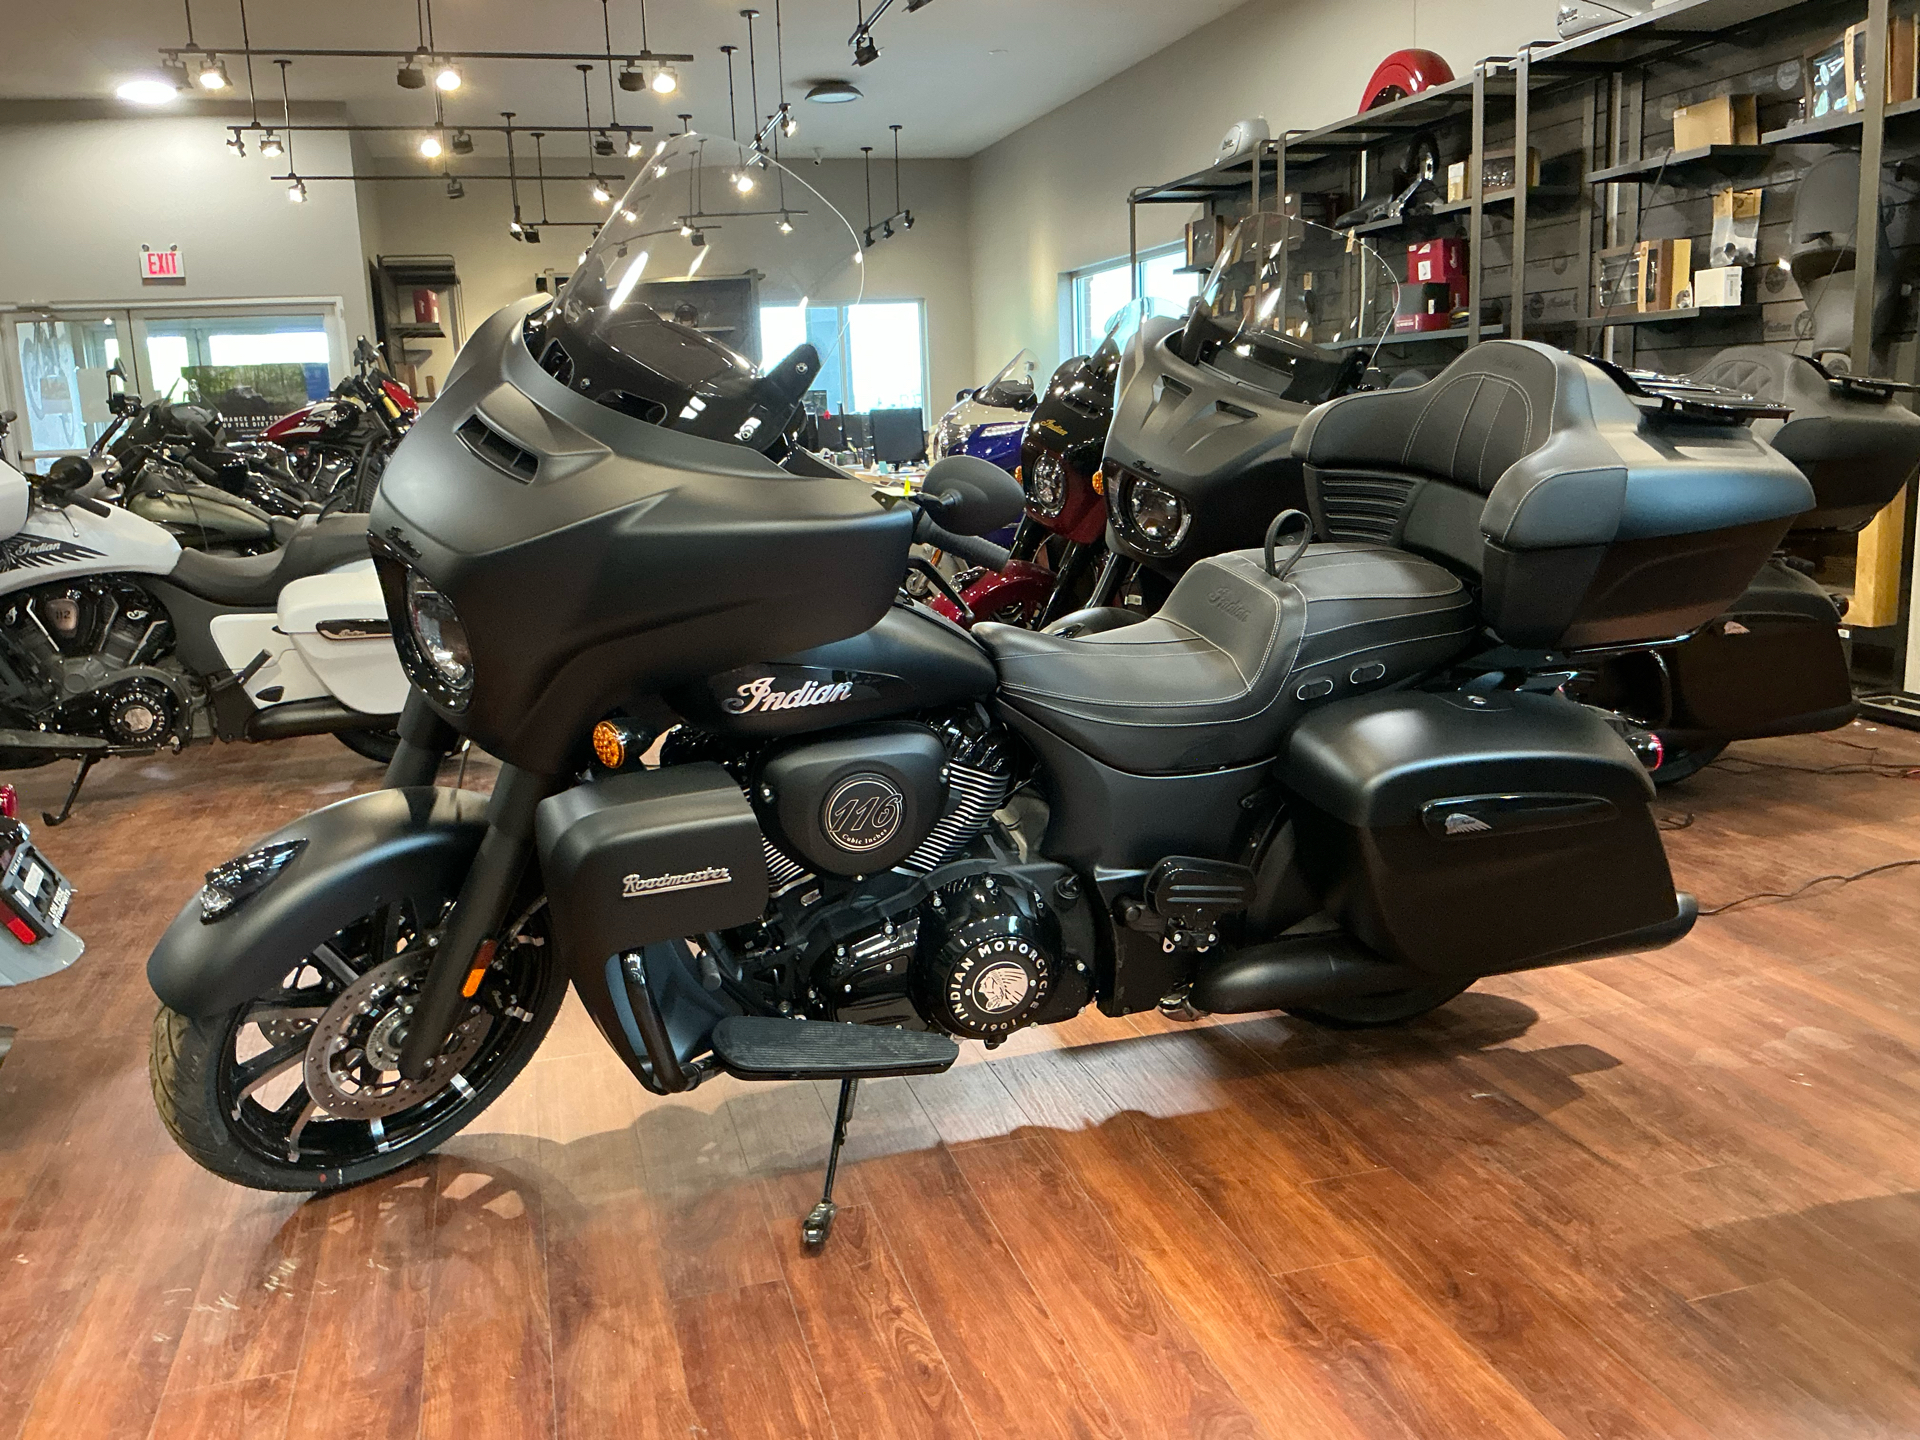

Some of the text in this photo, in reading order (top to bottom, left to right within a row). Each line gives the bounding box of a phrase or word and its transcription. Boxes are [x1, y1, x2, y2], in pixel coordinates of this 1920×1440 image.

[147, 252, 177, 275] EXIT
[15, 542, 61, 556] Indian
[55, 610, 71, 619] 112
[722, 677, 853, 714] Indian
[829, 793, 903, 833] 116
[842, 828, 888, 845] Cubic Inches
[622, 866, 731, 893] Roadmaster
[950, 940, 1049, 1020] INDIAN MOTORCYCLE
[980, 1018, 1018, 1031] 1901
